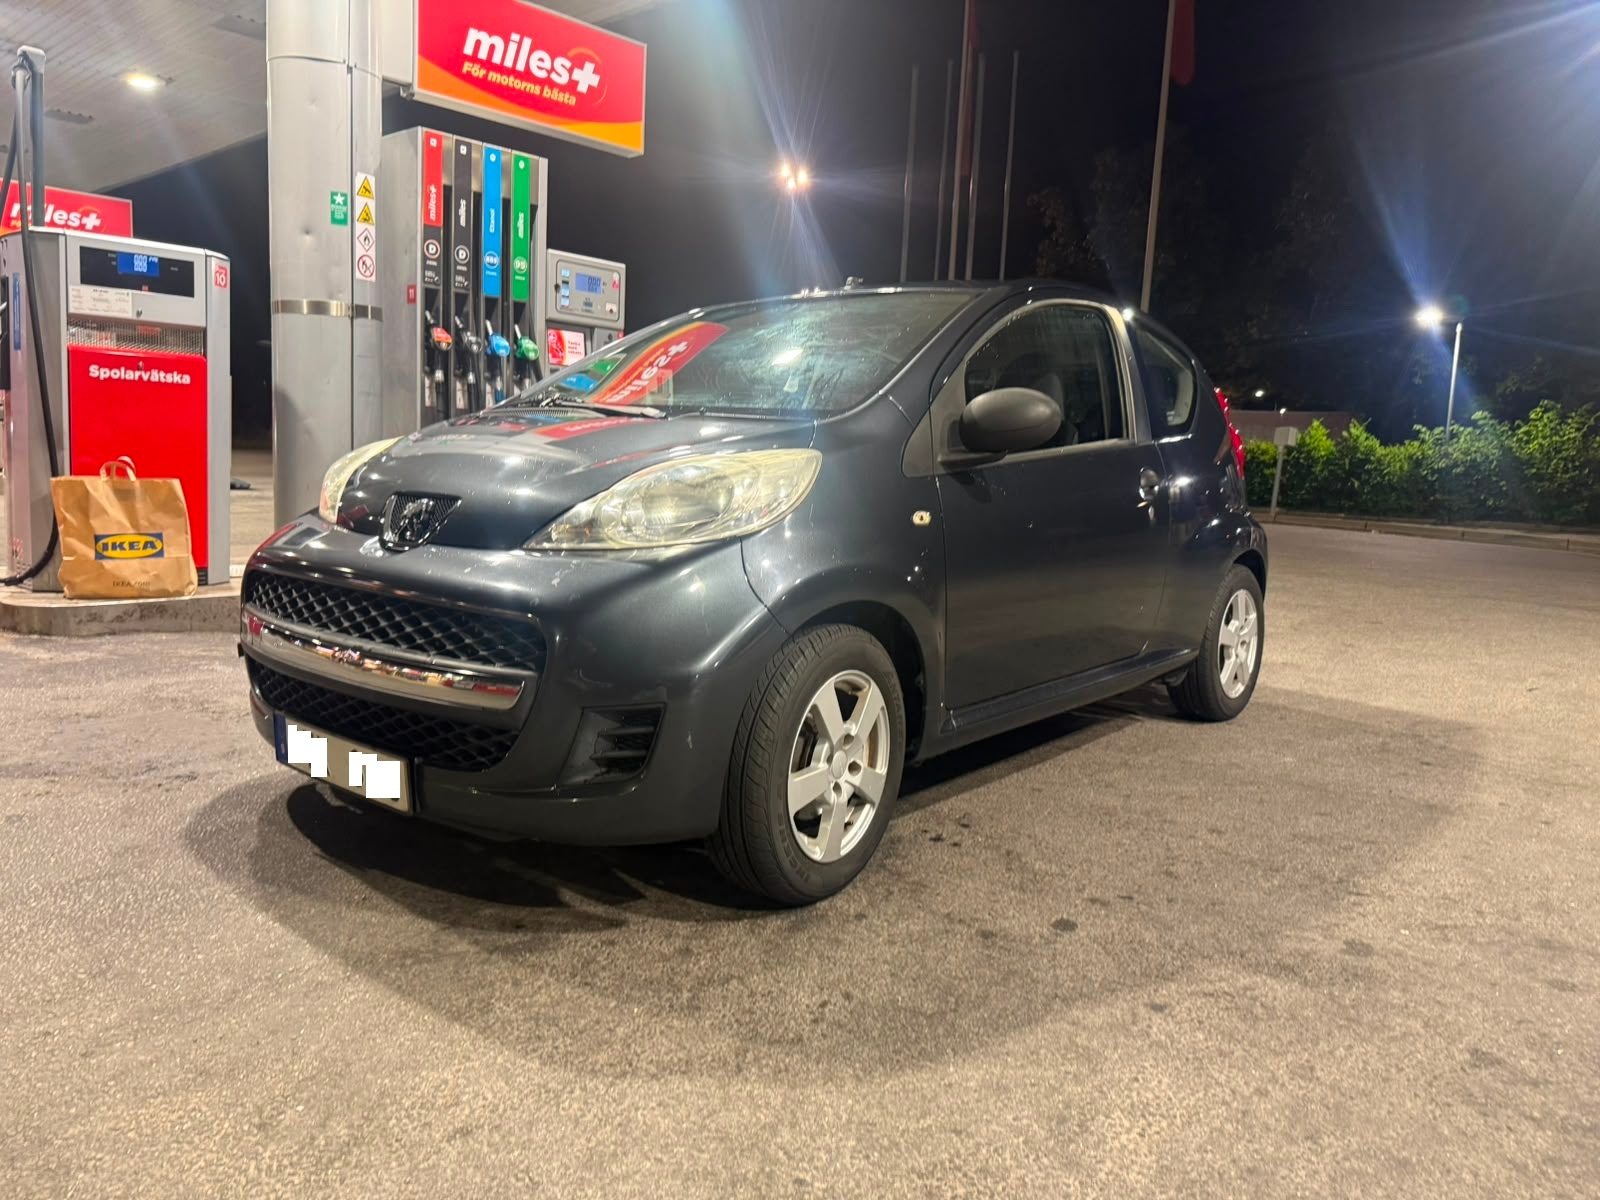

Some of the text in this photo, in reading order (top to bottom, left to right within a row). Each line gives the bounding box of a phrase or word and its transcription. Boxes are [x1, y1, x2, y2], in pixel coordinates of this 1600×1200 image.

[463, 27, 600, 94] miles+
[462, 62, 577, 106] För motorns bästa
[10, 203, 101, 231] mles+
[428, 243, 437, 254] D
[458, 249, 467, 260] D
[215, 272, 226, 287] 10
[88, 364, 191, 385] Spolarvätska
[102, 540, 158, 552] IKEA
